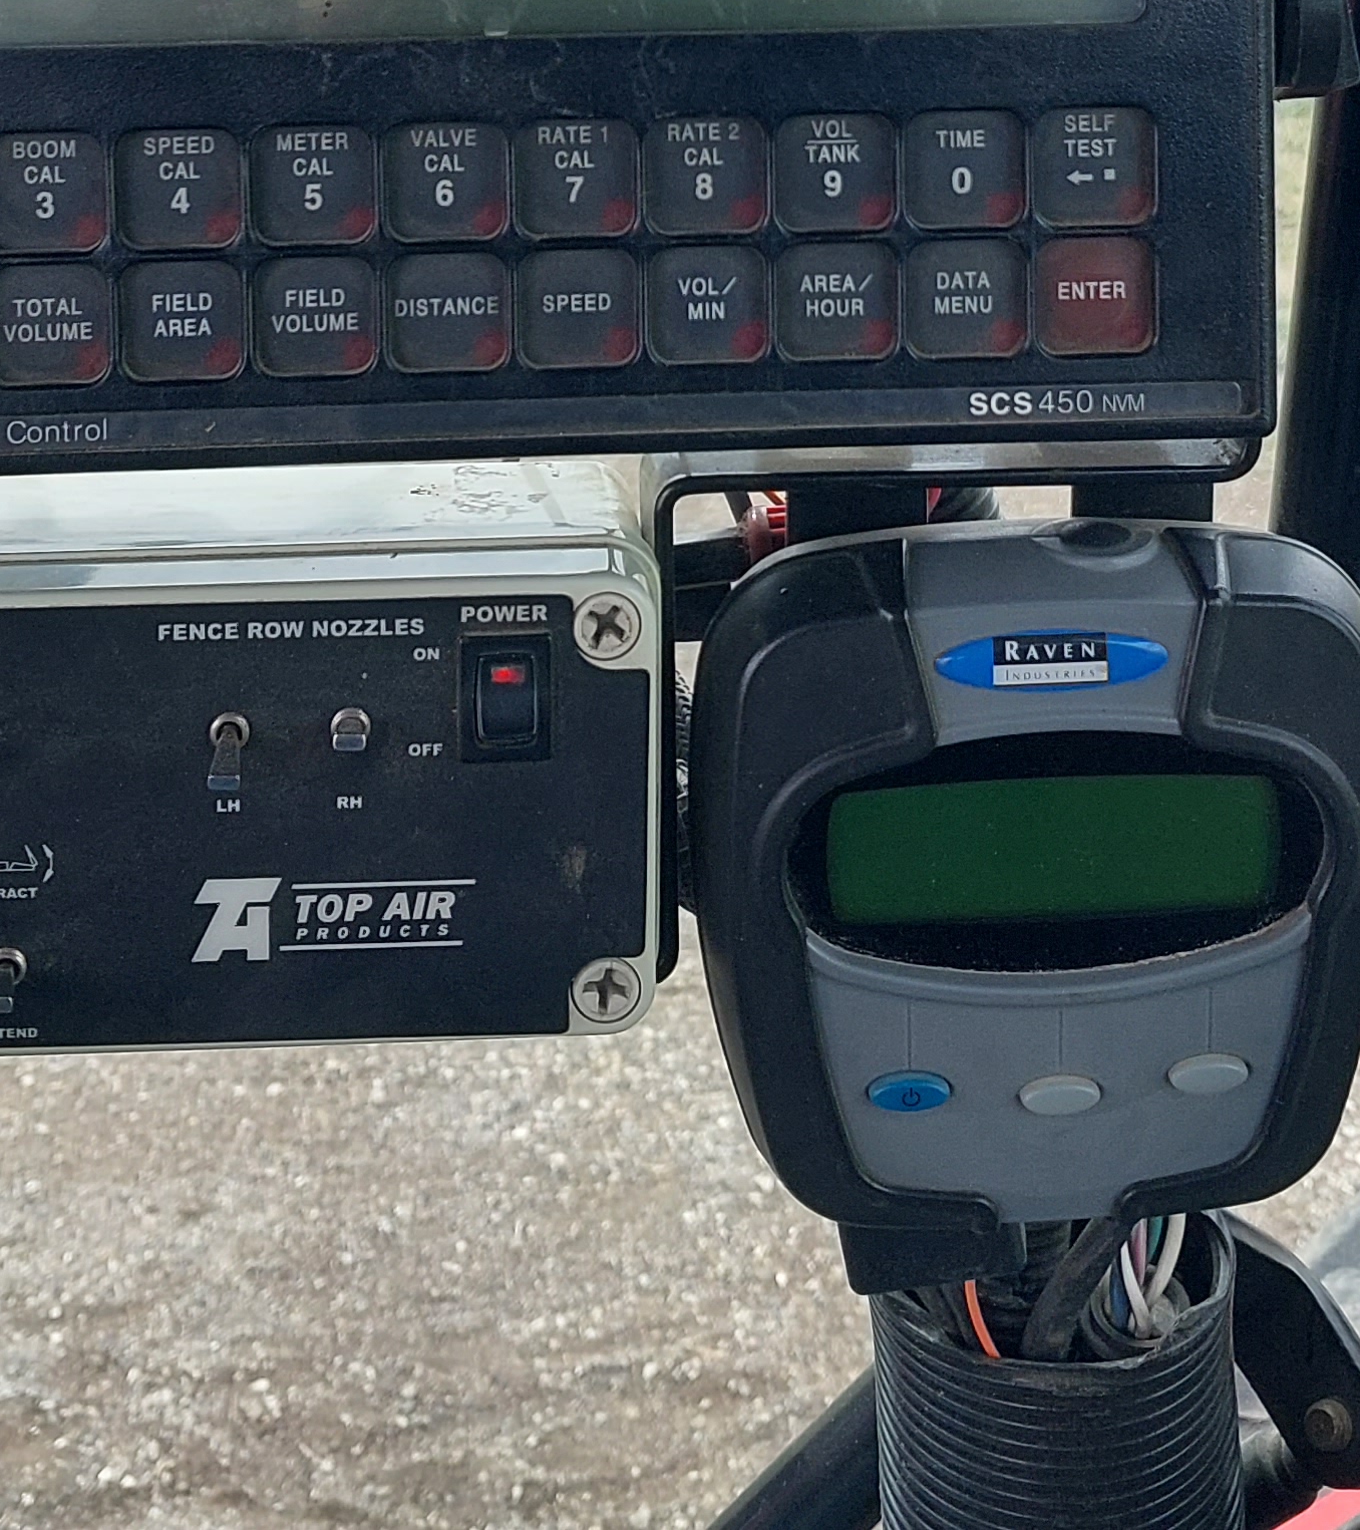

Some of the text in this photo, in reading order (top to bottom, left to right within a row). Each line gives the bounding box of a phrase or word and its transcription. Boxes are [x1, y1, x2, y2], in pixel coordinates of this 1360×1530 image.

[667, 122, 740, 142] RATE 2
[811, 121, 851, 138] VOL
[1064, 113, 1116, 133] SELF
[276, 132, 349, 152] METER
[410, 128, 477, 148] VALVE
[537, 125, 608, 145] RATE 1
[935, 129, 986, 149] TIME
[12, 139, 76, 159] BOOM
[143, 135, 215, 156] SPEED
[805, 145, 860, 163] TANK
[1063, 138, 1117, 158] TEST
[292, 157, 334, 177] CAL
[424, 153, 465, 173] CAL
[554, 149, 595, 169] CAL
[684, 147, 724, 167] CAL
[23, 165, 66, 185] CAL
[159, 161, 201, 181] CAL
[951, 166, 972, 194] 0
[435, 179, 454, 207] 6
[565, 175, 584, 203] 7
[695, 172, 714, 200] 8
[823, 169, 842, 197] 9
[35, 191, 55, 219] 3
[170, 187, 190, 214] 4
[304, 183, 323, 211] 5
[677, 276, 737, 297] VOL/
[799, 273, 873, 293] AREA/
[936, 270, 991, 290] DATA
[1057, 280, 1127, 300] ENTER
[11, 297, 83, 318] TOTAL
[152, 292, 213, 313] FIELD
[285, 288, 345, 308] FIELD
[395, 296, 499, 317] DISTANCE
[542, 292, 612, 313] SPEED
[806, 298, 864, 318] HOUR
[934, 295, 993, 315] MENU
[688, 301, 725, 321] MIN
[2, 321, 93, 343] VOLUME
[153, 317, 212, 338] AREA
[271, 312, 359, 334] VOLUME
[969, 390, 1145, 416] SCS 450 NVM
[6, 417, 107, 444] Control
[460, 604, 548, 623] POWER
[158, 618, 425, 641] FENCE ROW NOZZLES
[413, 647, 440, 661] ON
[1005, 641, 1095, 661] RAVEN
[408, 742, 443, 757] OFF
[216, 798, 241, 813] LH
[336, 796, 363, 810] RH
[295, 891, 456, 923] TOP AIR
[296, 924, 449, 940] PRODUCTS
